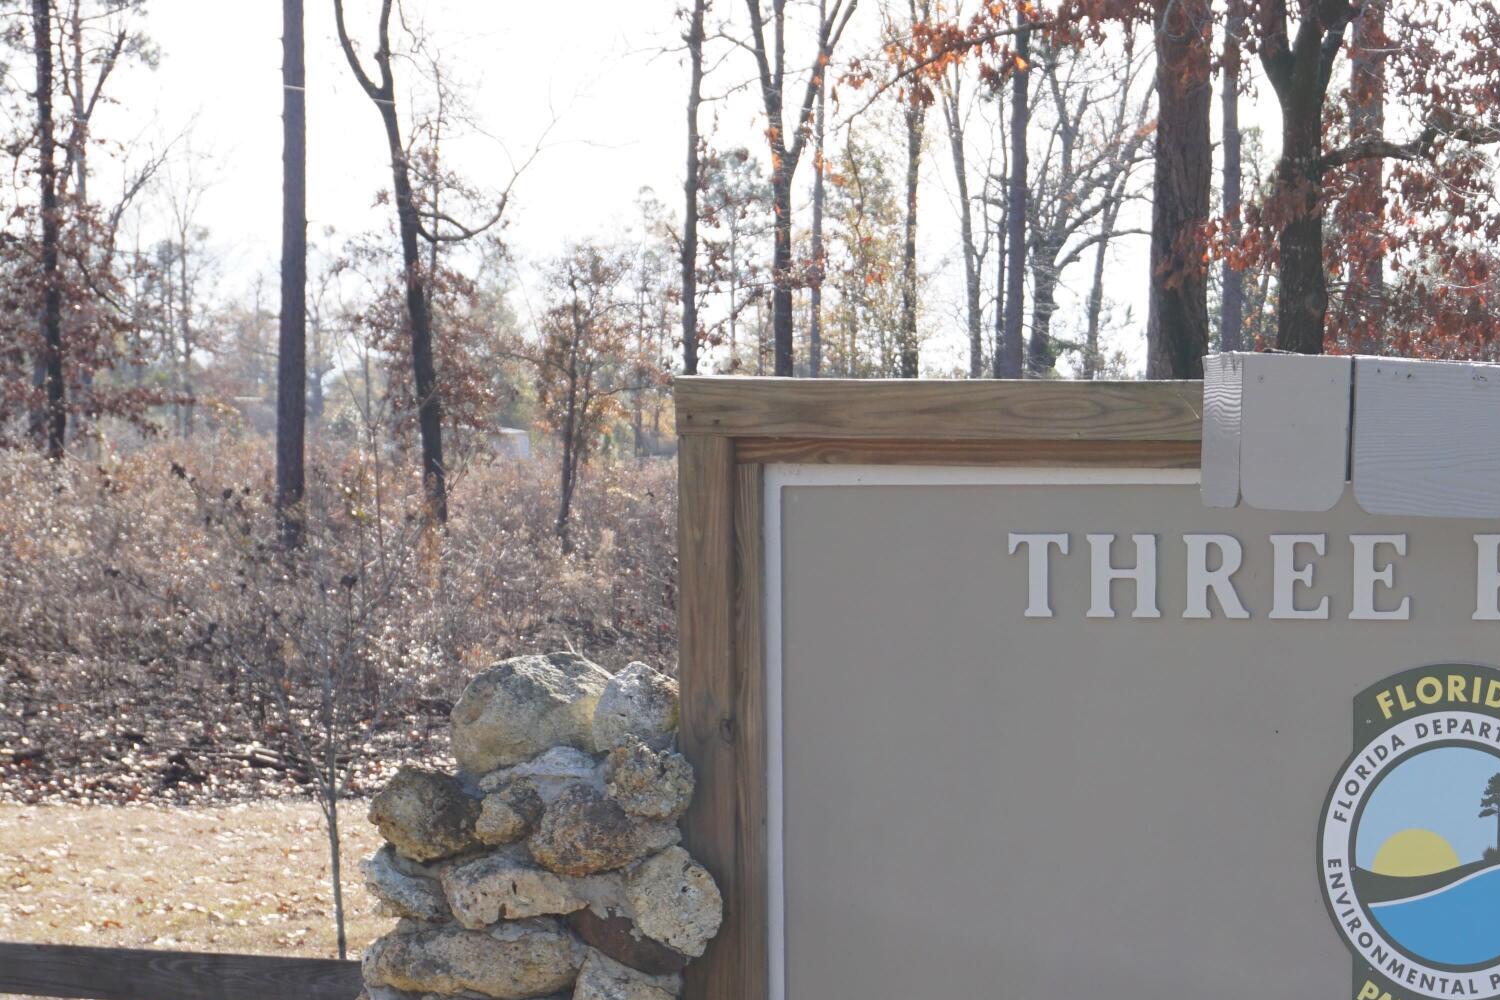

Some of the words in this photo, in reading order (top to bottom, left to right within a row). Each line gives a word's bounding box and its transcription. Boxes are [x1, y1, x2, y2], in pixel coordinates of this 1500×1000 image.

[1007, 532, 1411, 620] THREE
[1333, 733, 1406, 824] FLORIDA
[1327, 858, 1478, 995] ENVIRONMENTAL
